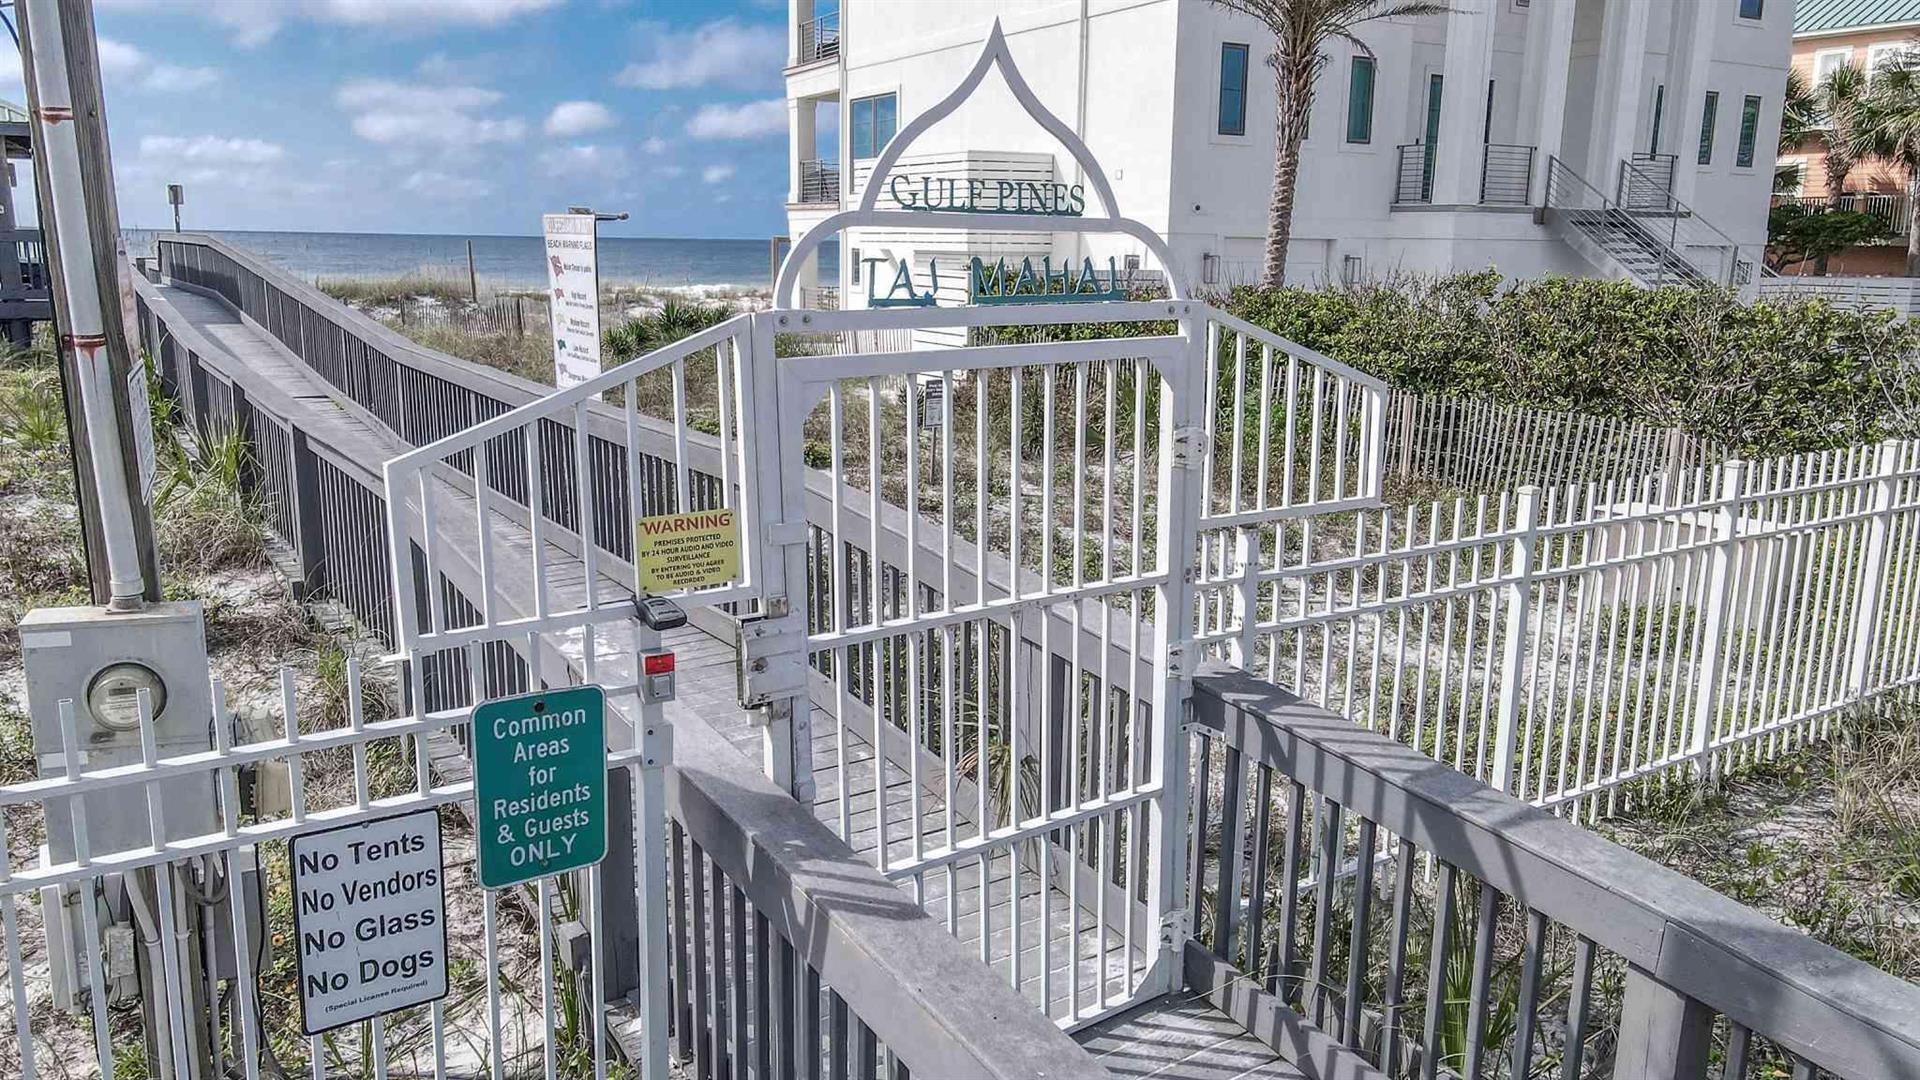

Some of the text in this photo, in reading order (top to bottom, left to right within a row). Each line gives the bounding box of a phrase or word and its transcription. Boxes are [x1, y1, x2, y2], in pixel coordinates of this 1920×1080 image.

[891, 175, 1085, 214] GULF PINES
[861, 255, 1127, 305] TAJ MAHAL
[643, 513, 730, 535] WARNING
[654, 533, 721, 547] PREMISES PROTECTED
[661, 548, 679, 556] HOUR
[680, 544, 700, 553] AUDIO
[716, 540, 734, 548] VIDEO
[666, 552, 711, 564] SURVEILLANCE
[660, 562, 691, 573] ENTERING
[706, 559, 724, 567] AGREE
[672, 576, 705, 586] RECORDED
[675, 570, 694, 578] AUDIO
[703, 566, 721, 574] VIDEO
[493, 708, 587, 739] Common
[513, 737, 570, 763] Areas
[528, 765, 557, 786] for
[494, 782, 591, 821] Residents
[497, 809, 590, 845] & Guests
[299, 832, 425, 876] No Tents
[510, 832, 577, 867] ONLY
[302, 868, 437, 915] No Vendors
[304, 908, 436, 956] No Glass
[308, 950, 434, 998] No Dogs
[324, 980, 428, 1013] (Special License Required)
